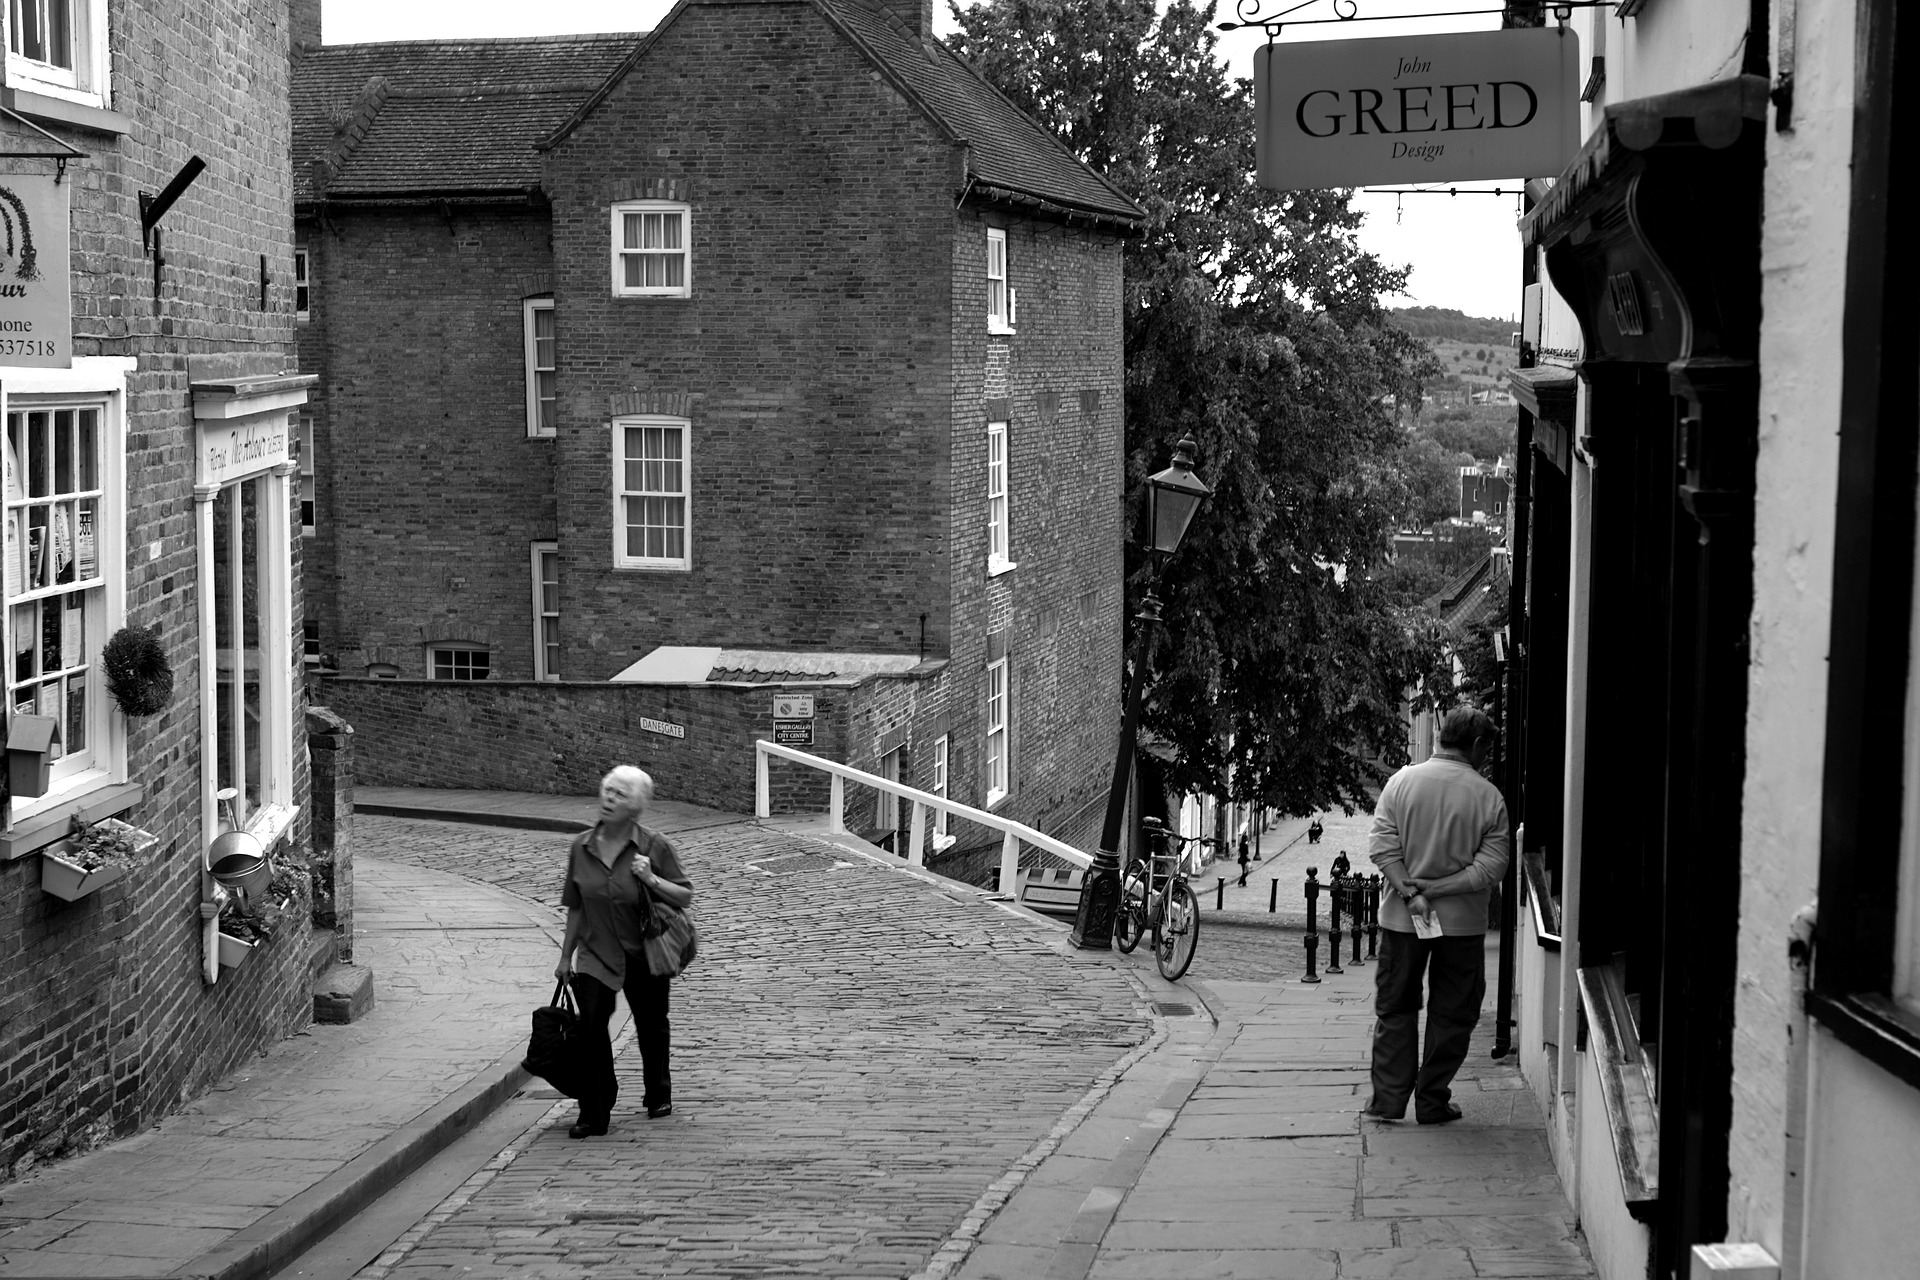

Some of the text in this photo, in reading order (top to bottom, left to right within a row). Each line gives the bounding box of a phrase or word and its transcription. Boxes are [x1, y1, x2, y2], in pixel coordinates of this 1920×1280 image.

[1393, 56, 1431, 80] John
[1296, 80, 1538, 137] GREED
[1391, 140, 1445, 163] Design
[642, 718, 683, 737] DANESGATE
